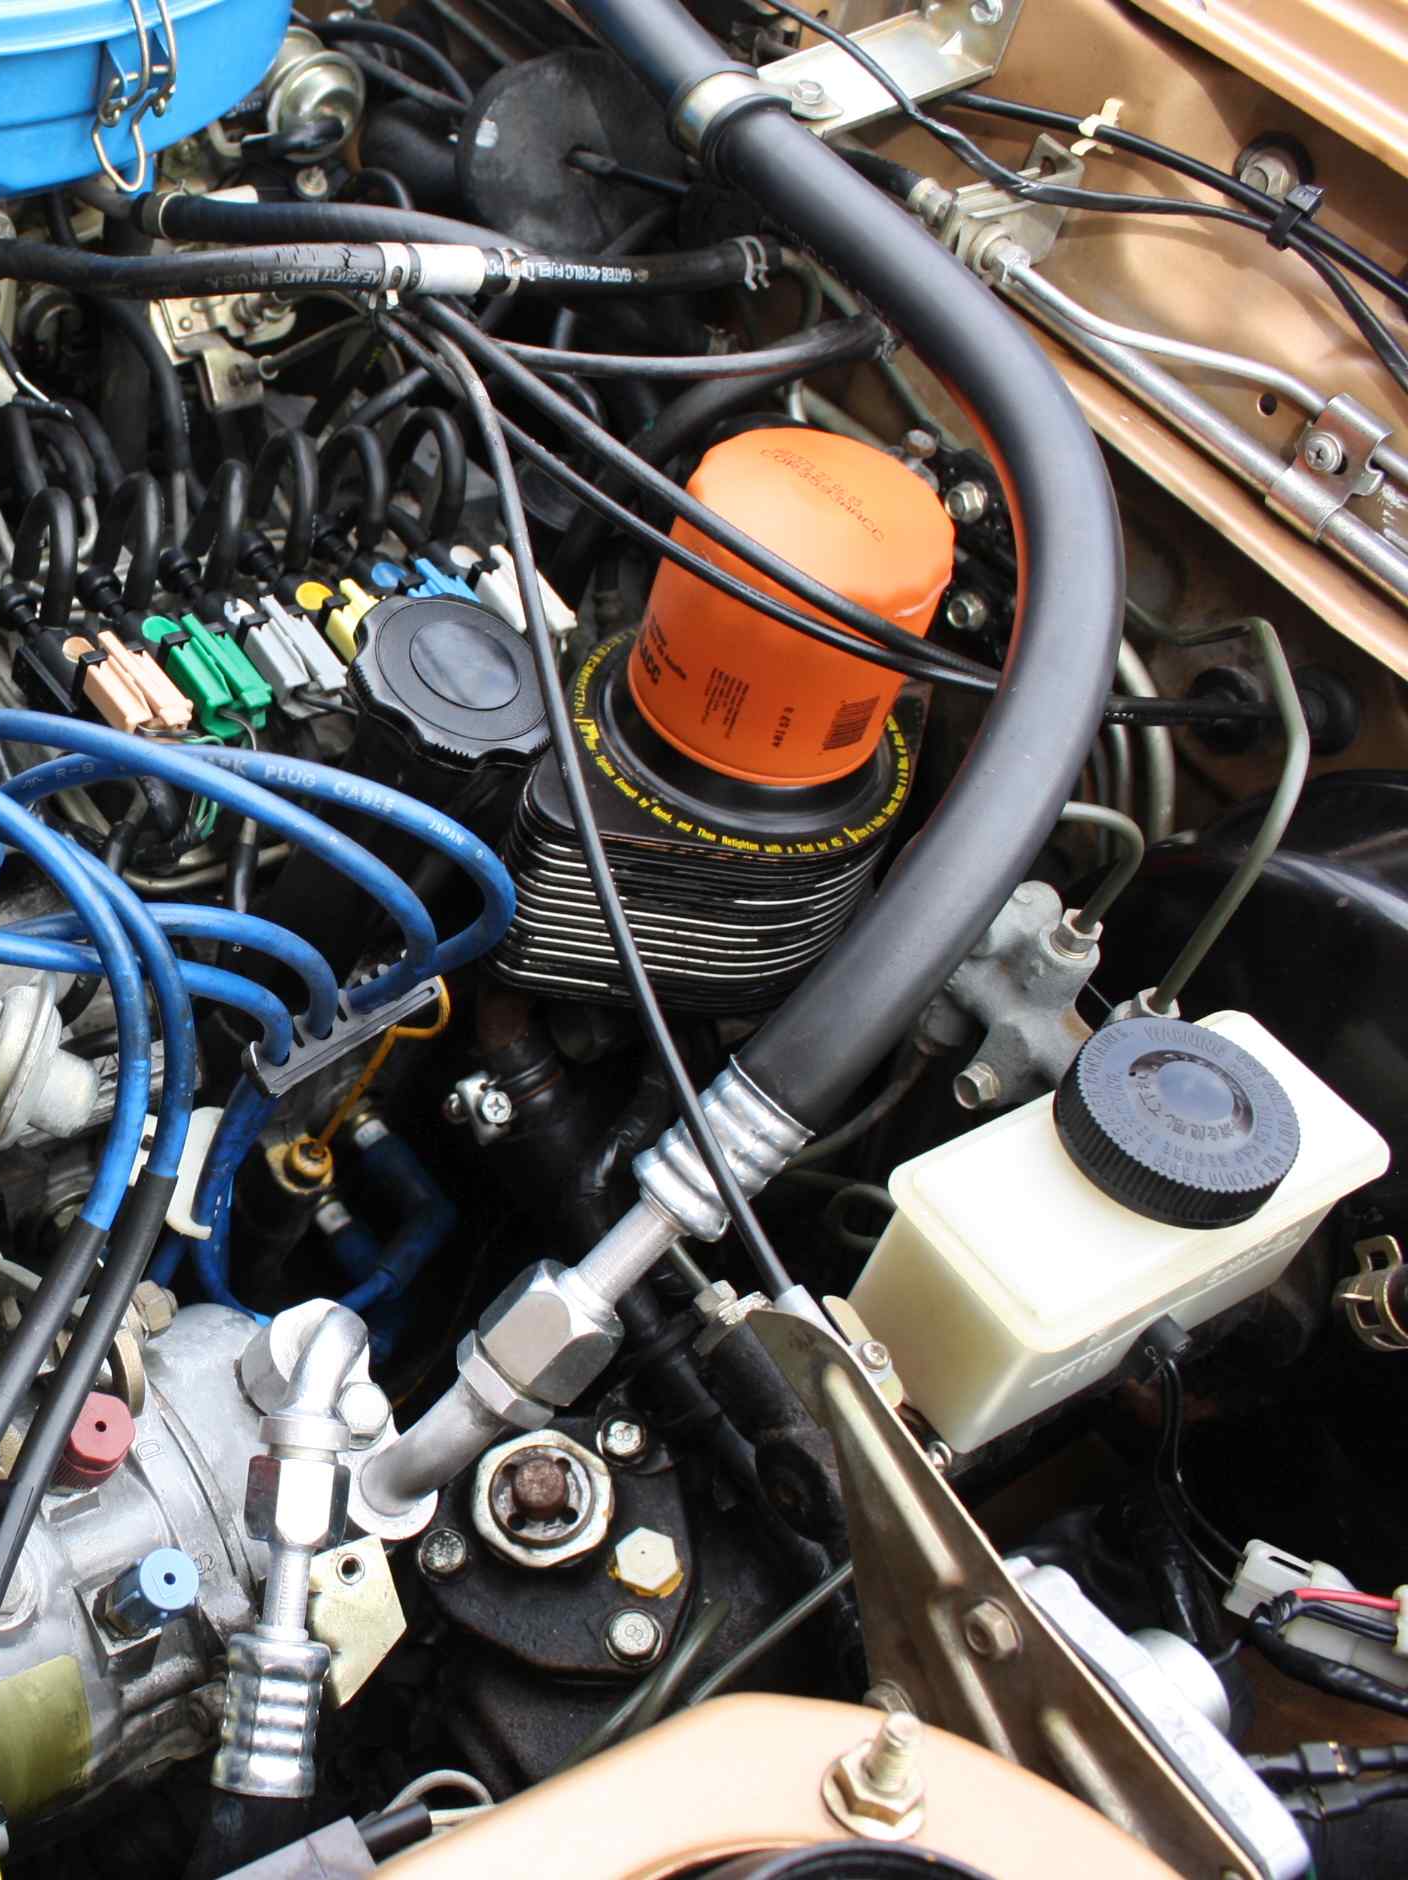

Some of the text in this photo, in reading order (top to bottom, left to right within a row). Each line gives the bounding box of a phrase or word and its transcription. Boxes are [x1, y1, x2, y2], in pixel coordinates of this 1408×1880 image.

[251, 272, 268, 287] IN
[273, 270, 319, 285] MADE
[263, 762, 318, 791] PLUG
[332, 778, 397, 814] CABLE
[426, 817, 467, 846] JAPAN
[698, 827, 717, 842] Then
